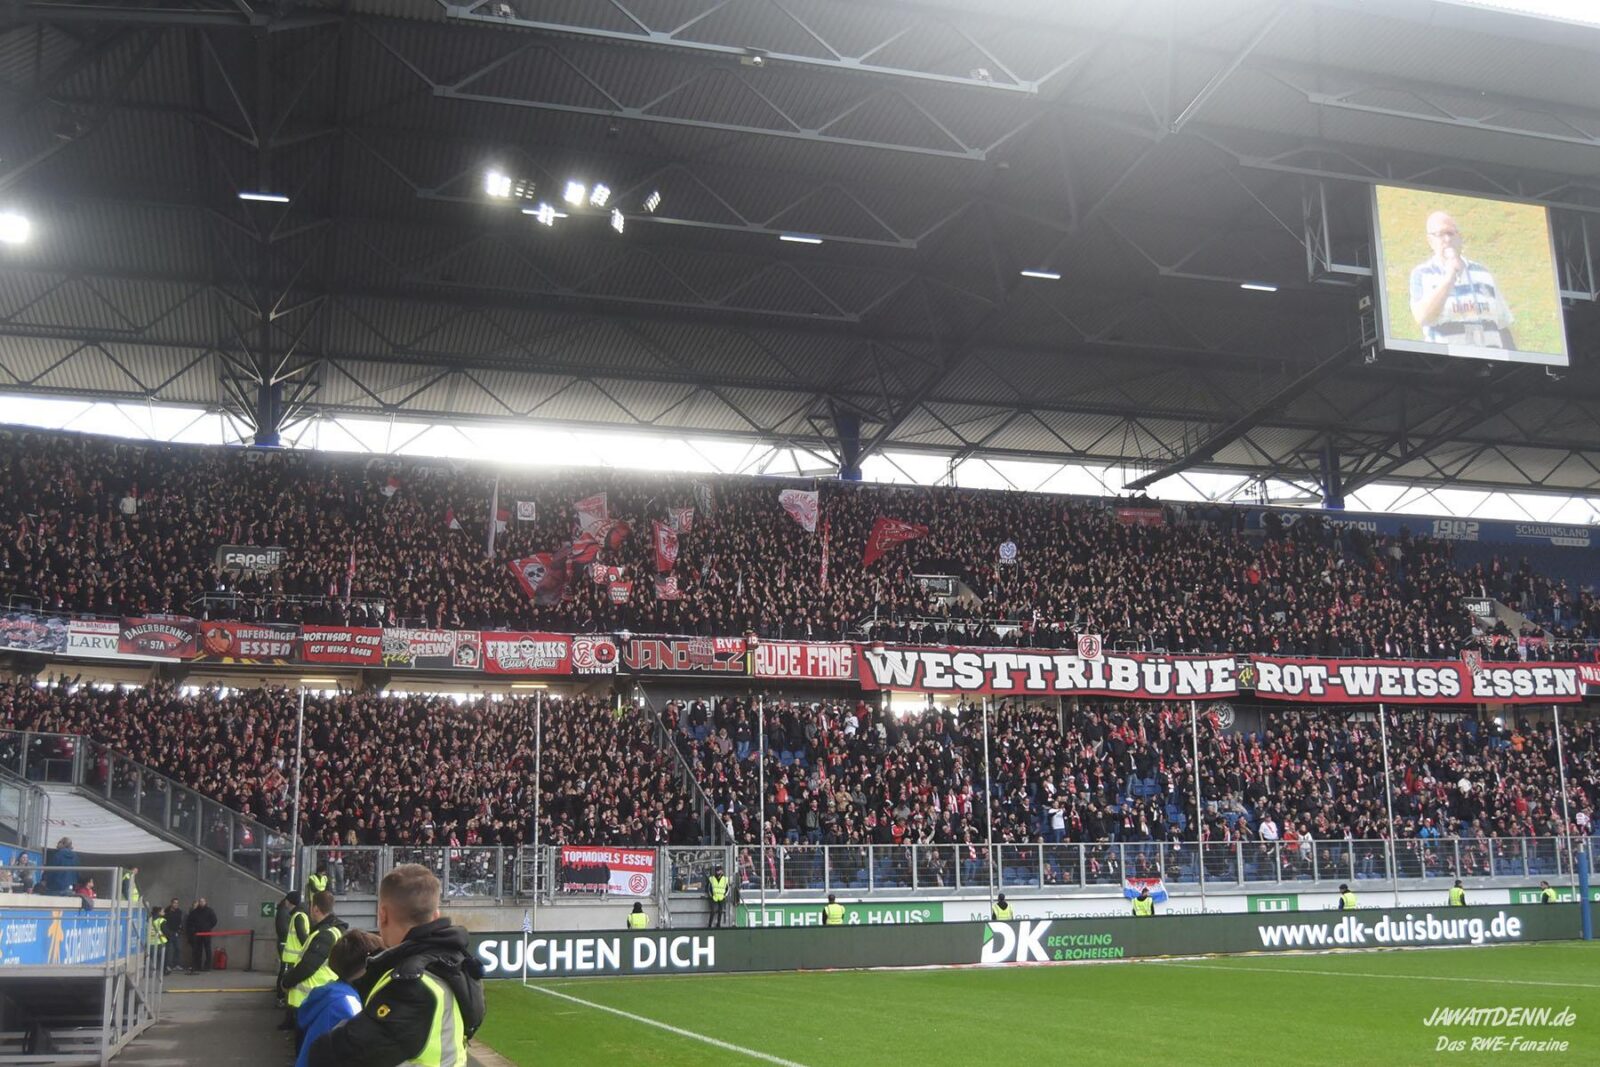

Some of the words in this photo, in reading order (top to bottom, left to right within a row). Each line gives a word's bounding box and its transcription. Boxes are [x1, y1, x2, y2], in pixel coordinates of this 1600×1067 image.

[1515, 525, 1589, 538] SCHAUINSLAND
[124, 623, 193, 644] DAUERBRENNER
[303, 632, 352, 643] NORTHSIDE
[355, 634, 381, 646] CREW
[387, 628, 452, 642] WRECKING
[457, 634, 478, 642] LPL
[150, 640, 165, 650] 97A
[240, 641, 291, 656] ESSEN
[310, 645, 324, 653] ROT
[716, 638, 742, 649] RVT
[755, 648, 801, 676] RUDE
[806, 646, 852, 676] FANS
[865, 651, 1236, 694] WESTTRIBÜNE
[1255, 662, 1461, 697] ROT-WEISS
[1472, 668, 1577, 696] ESSEN
[563, 851, 621, 864] TOPMODELS
[622, 853, 653, 866] ESSEN
[1259, 911, 1521, 946] www.dk-duisburg.de
[981, 920, 1053, 963] DK
[1047, 934, 1112, 947] RECYCLING
[478, 938, 620, 972] SUCHEN
[634, 936, 715, 968] DICH
[1054, 949, 1064, 960] &
[1065, 946, 1124, 960] ROHEISEN
